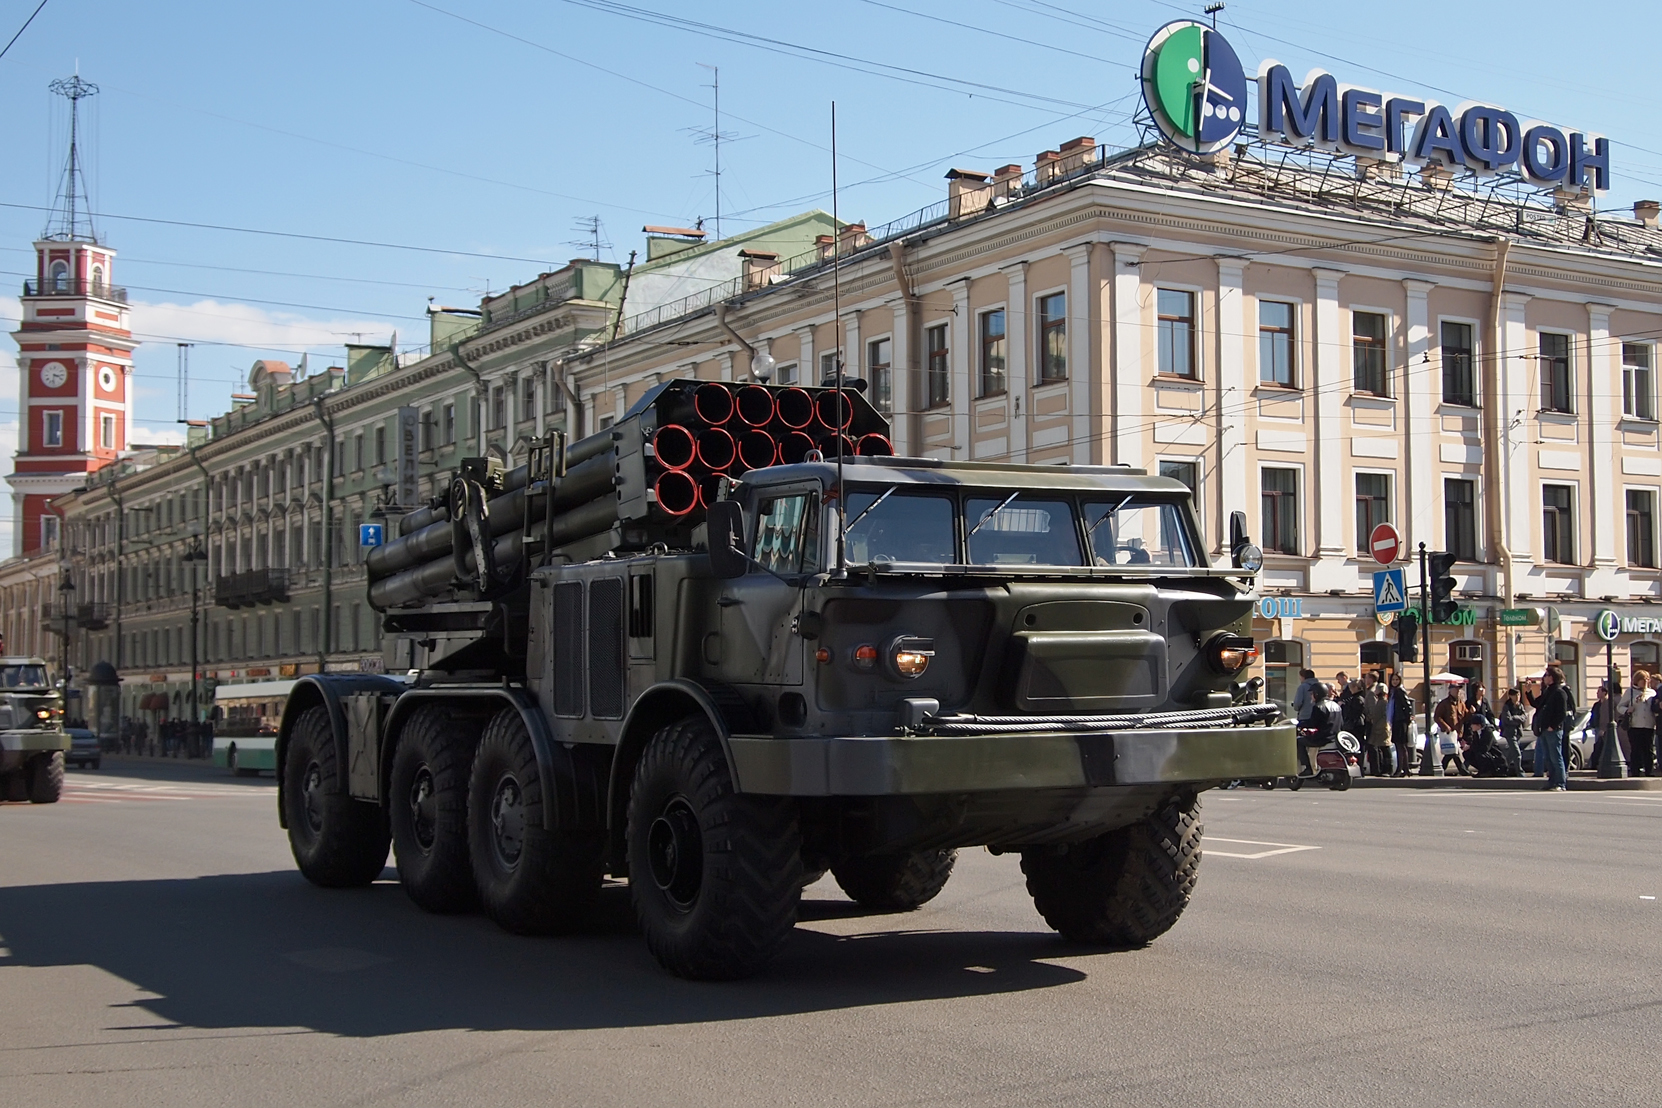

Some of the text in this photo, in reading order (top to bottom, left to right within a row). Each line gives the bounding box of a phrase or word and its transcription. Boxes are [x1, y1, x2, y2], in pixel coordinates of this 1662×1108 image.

[1262, 60, 1610, 193] МЕГАФОН
[402, 414, 416, 506] ЮВЕЛИР
[1622, 616, 1662, 633] МЕГА
